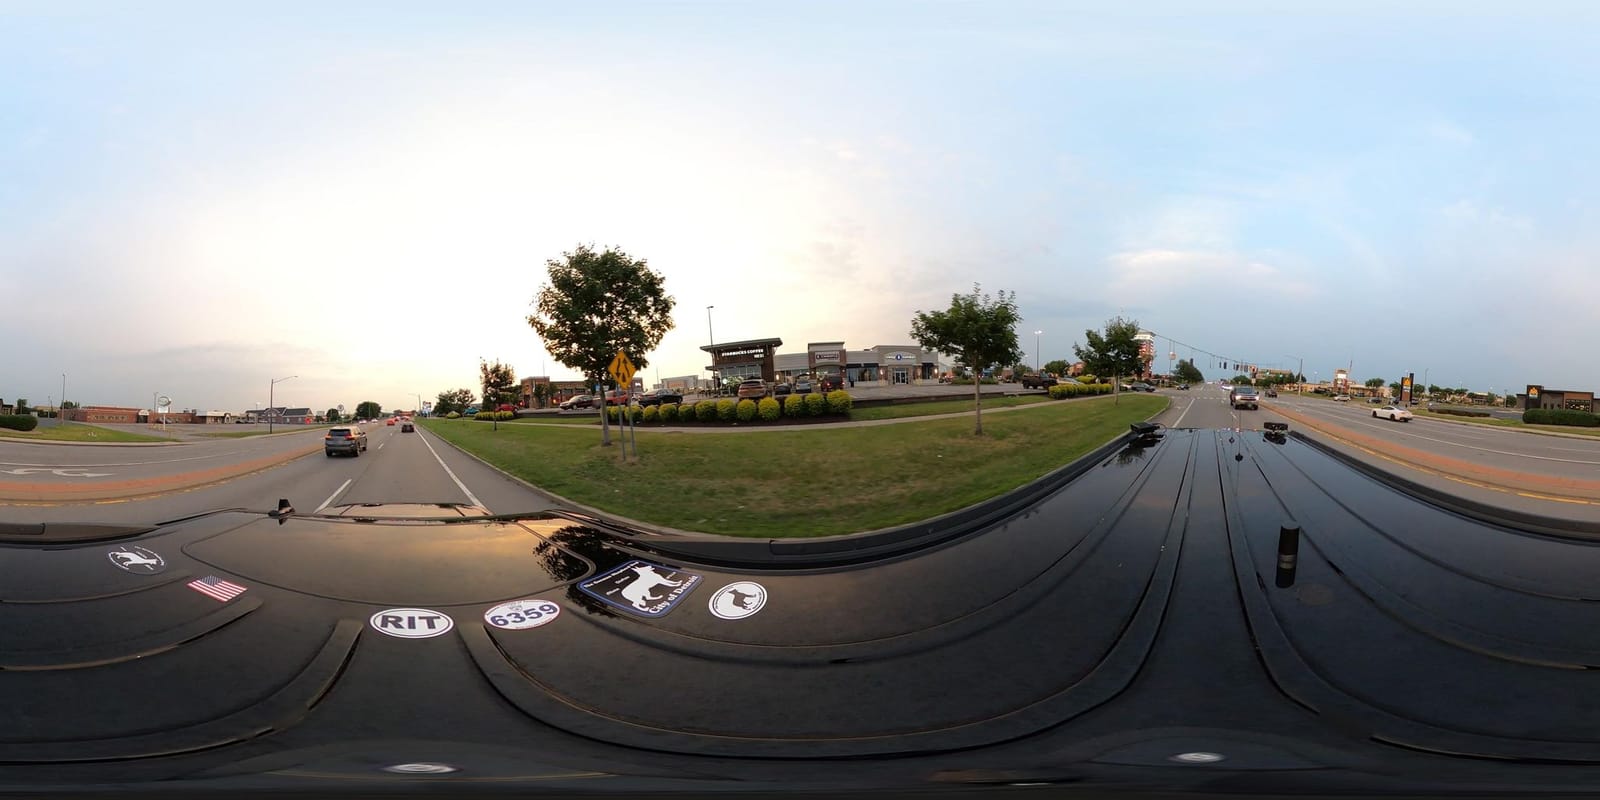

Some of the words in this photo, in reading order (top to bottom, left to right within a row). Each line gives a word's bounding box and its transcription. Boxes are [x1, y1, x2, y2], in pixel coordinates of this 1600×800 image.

[649, 601, 670, 613] City
[668, 593, 678, 601] of
[673, 575, 698, 594] Detroit
[380, 615, 440, 630] RIT
[490, 604, 558, 626] 6359
